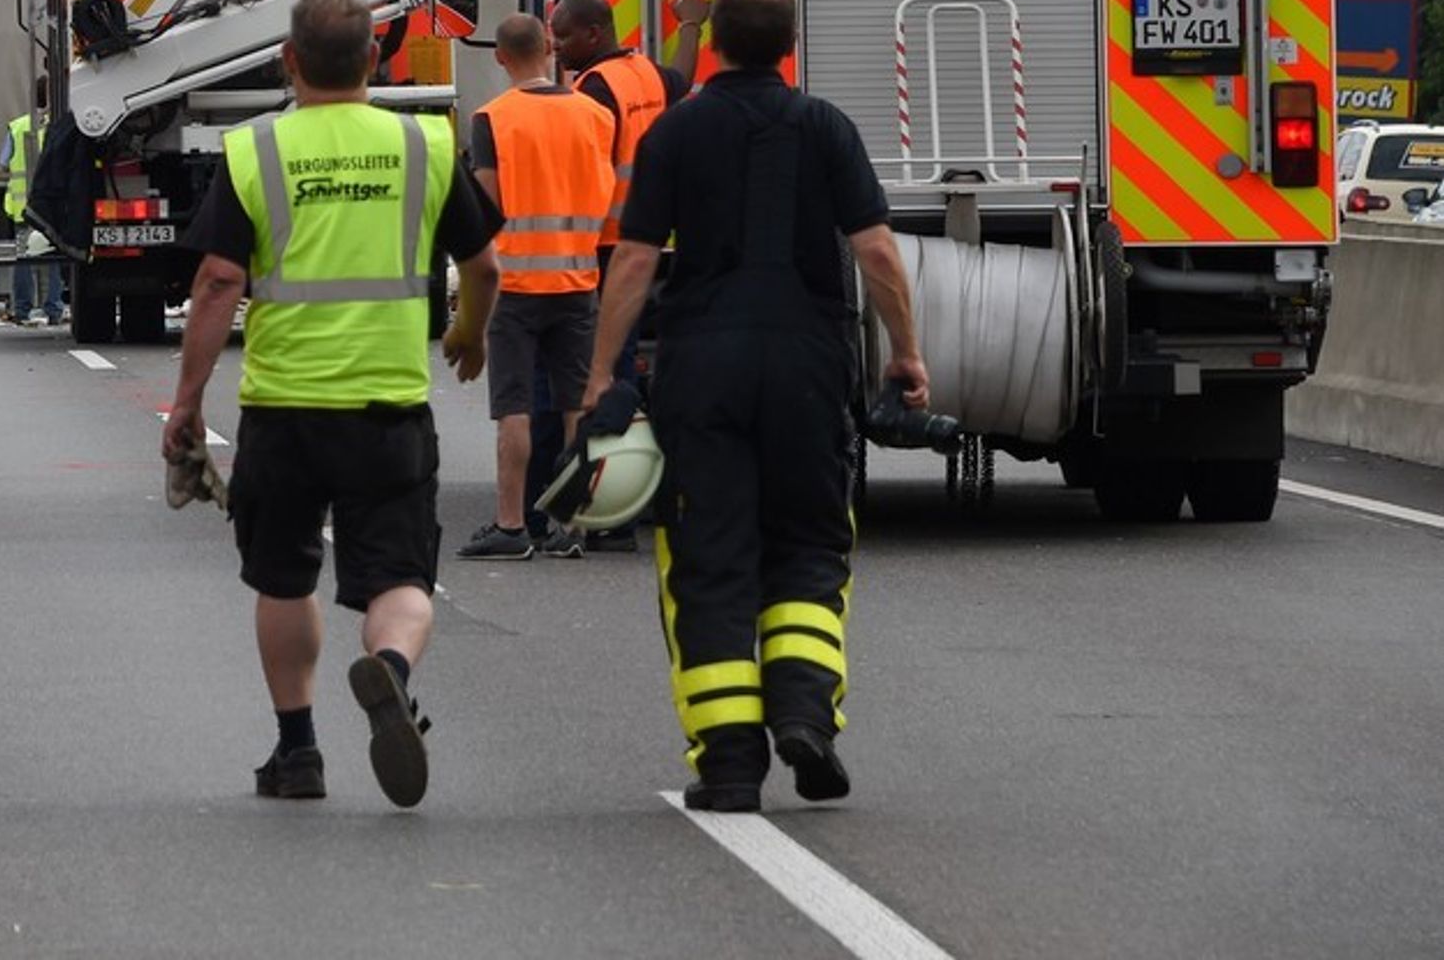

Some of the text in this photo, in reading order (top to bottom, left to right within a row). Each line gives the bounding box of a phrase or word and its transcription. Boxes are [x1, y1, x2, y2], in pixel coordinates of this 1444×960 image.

[1143, 19, 1233, 44] FW 401
[1335, 84, 1394, 109] rock
[287, 154, 401, 176] BERGUNGSLEITER
[294, 177, 392, 207] Schnittger
[97, 228, 118, 242] KS
